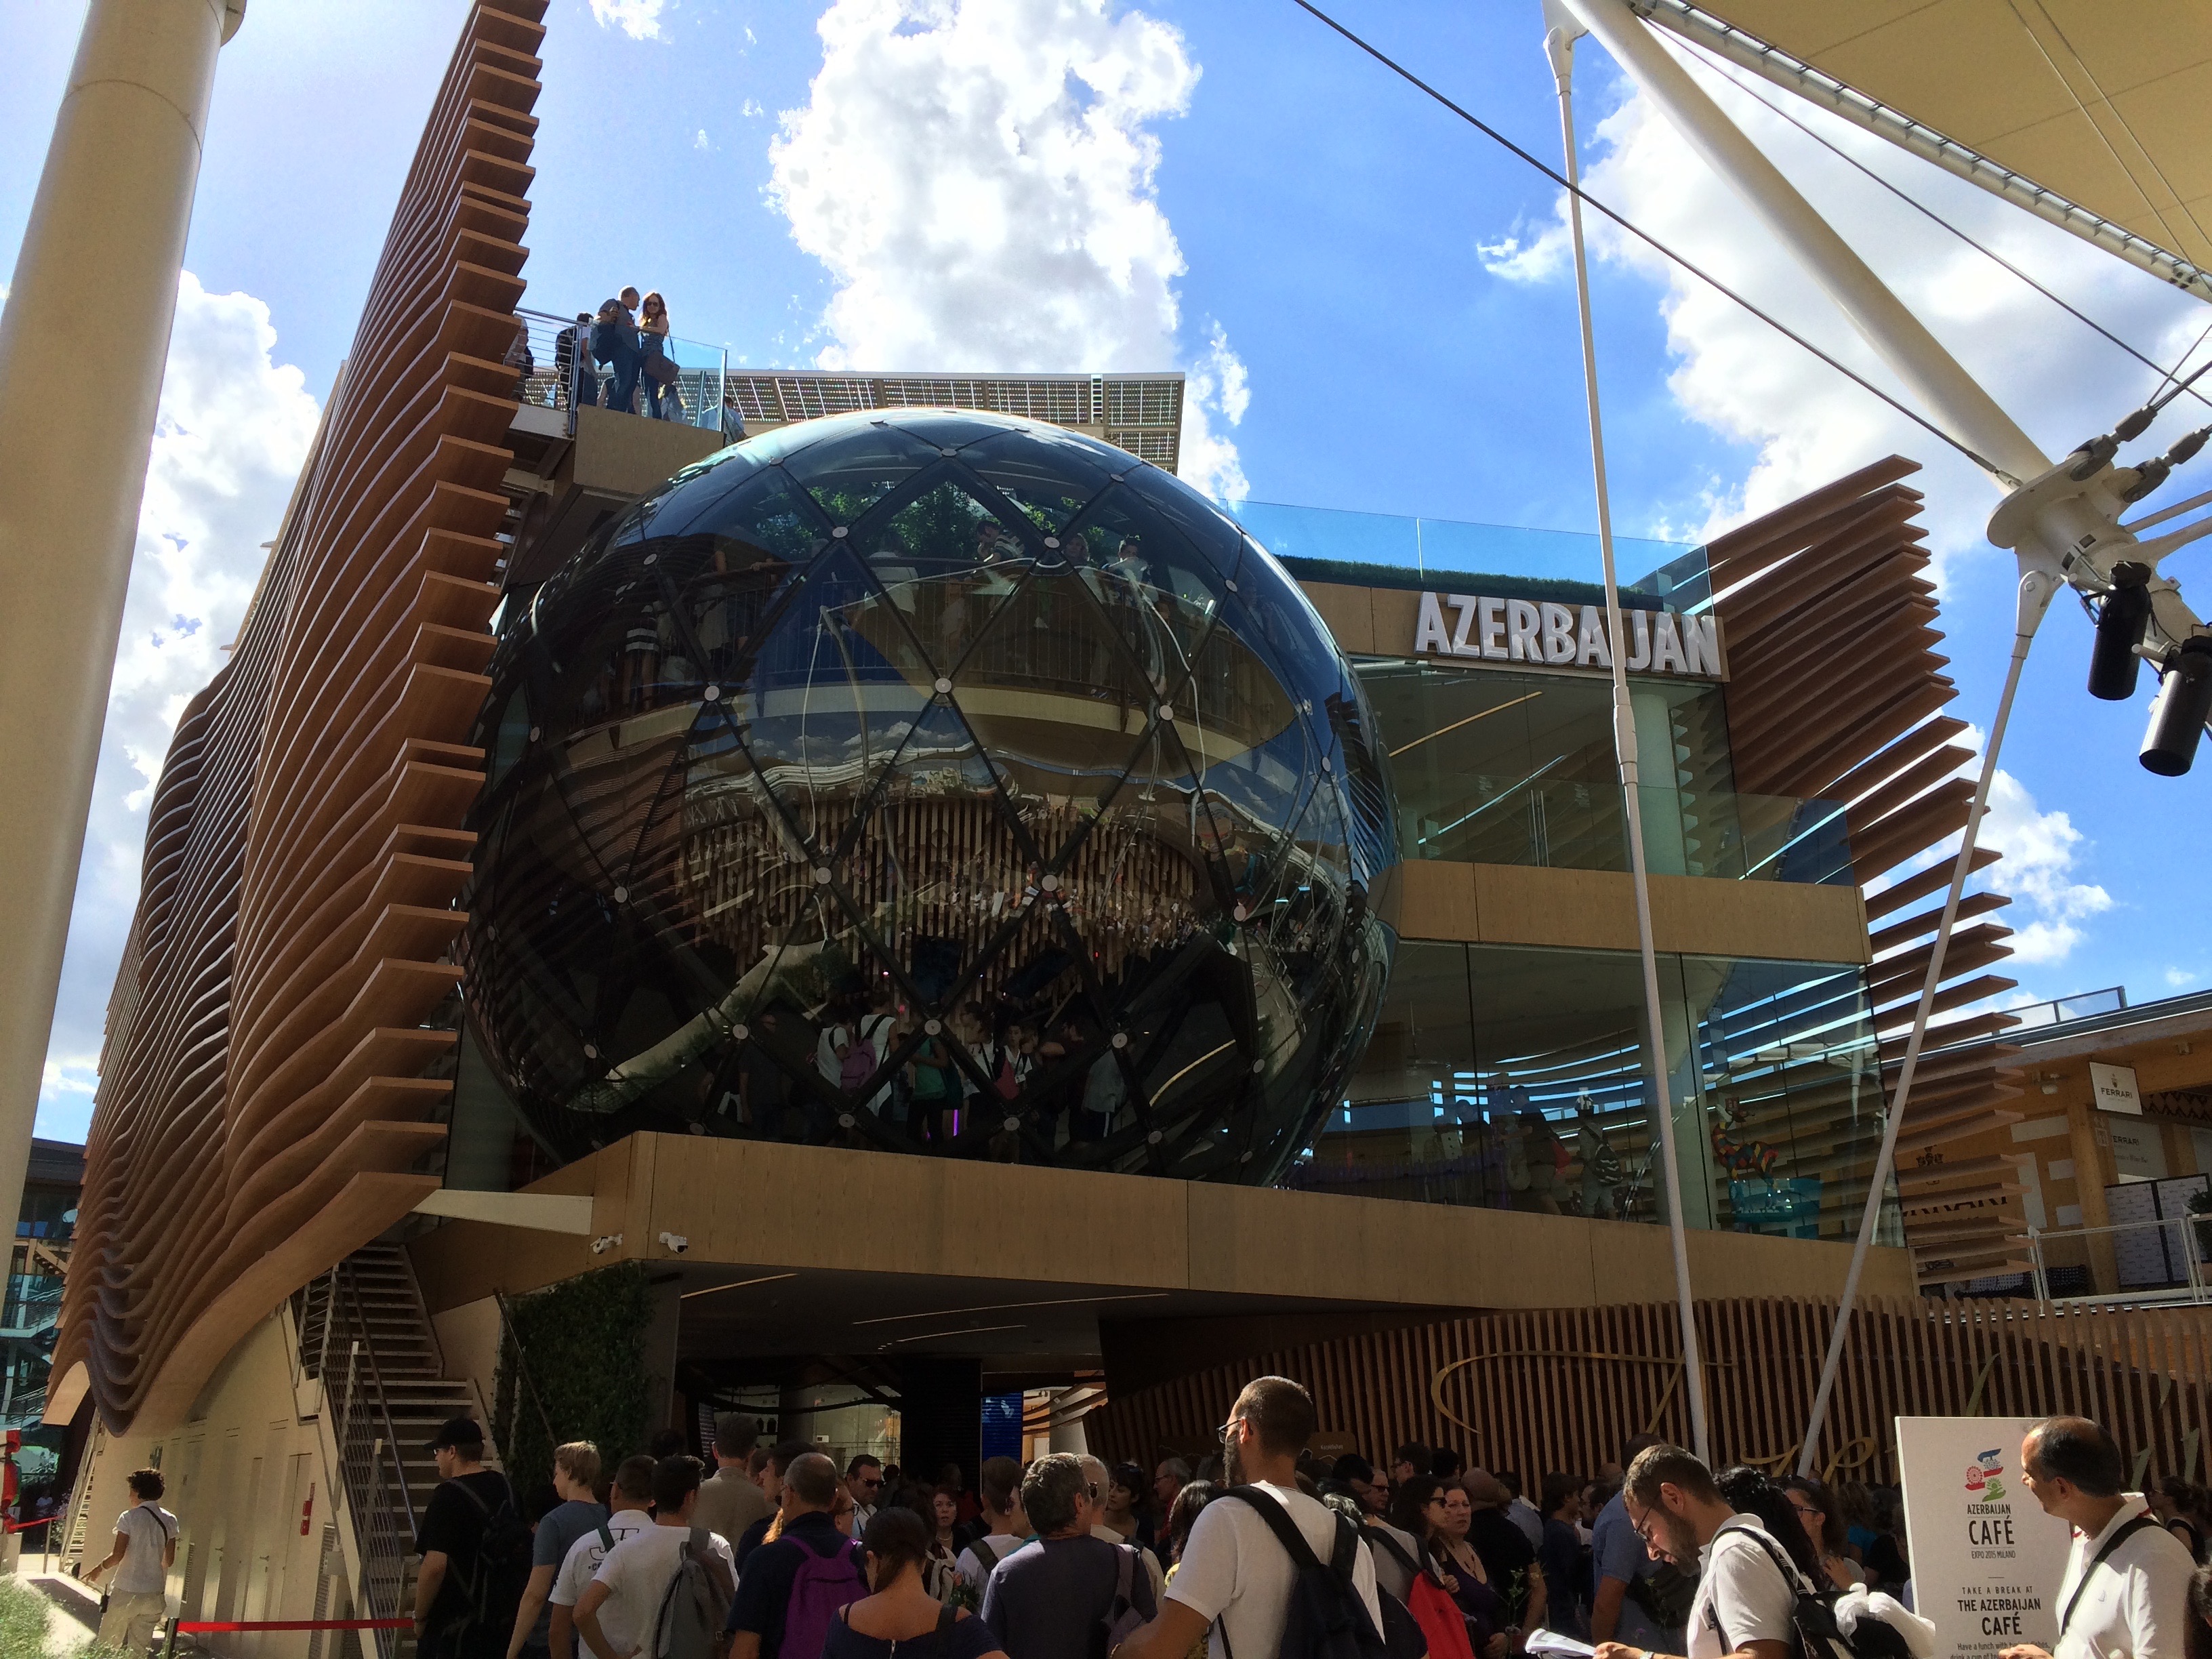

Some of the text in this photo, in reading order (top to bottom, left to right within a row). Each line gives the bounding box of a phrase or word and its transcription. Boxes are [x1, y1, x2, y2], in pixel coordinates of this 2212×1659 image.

[1414, 592, 1721, 676] AZERBAJAN
[2101, 1088, 2133, 1099] FERRARI
[2112, 1135, 2139, 1146] ERRARI
[1967, 1504, 2011, 1515] AZERBAIJAN
[1969, 1515, 2015, 1545] CAFÉ
[1971, 1550, 2016, 1559] EXPO 2015 MILANO
[1957, 1598, 2041, 1612] THE AZERBAIJAN
[1982, 1612, 2022, 1636] CAFÉ
[1957, 1643, 1972, 1651] Have
[1978, 1642, 1994, 1650] lunch
